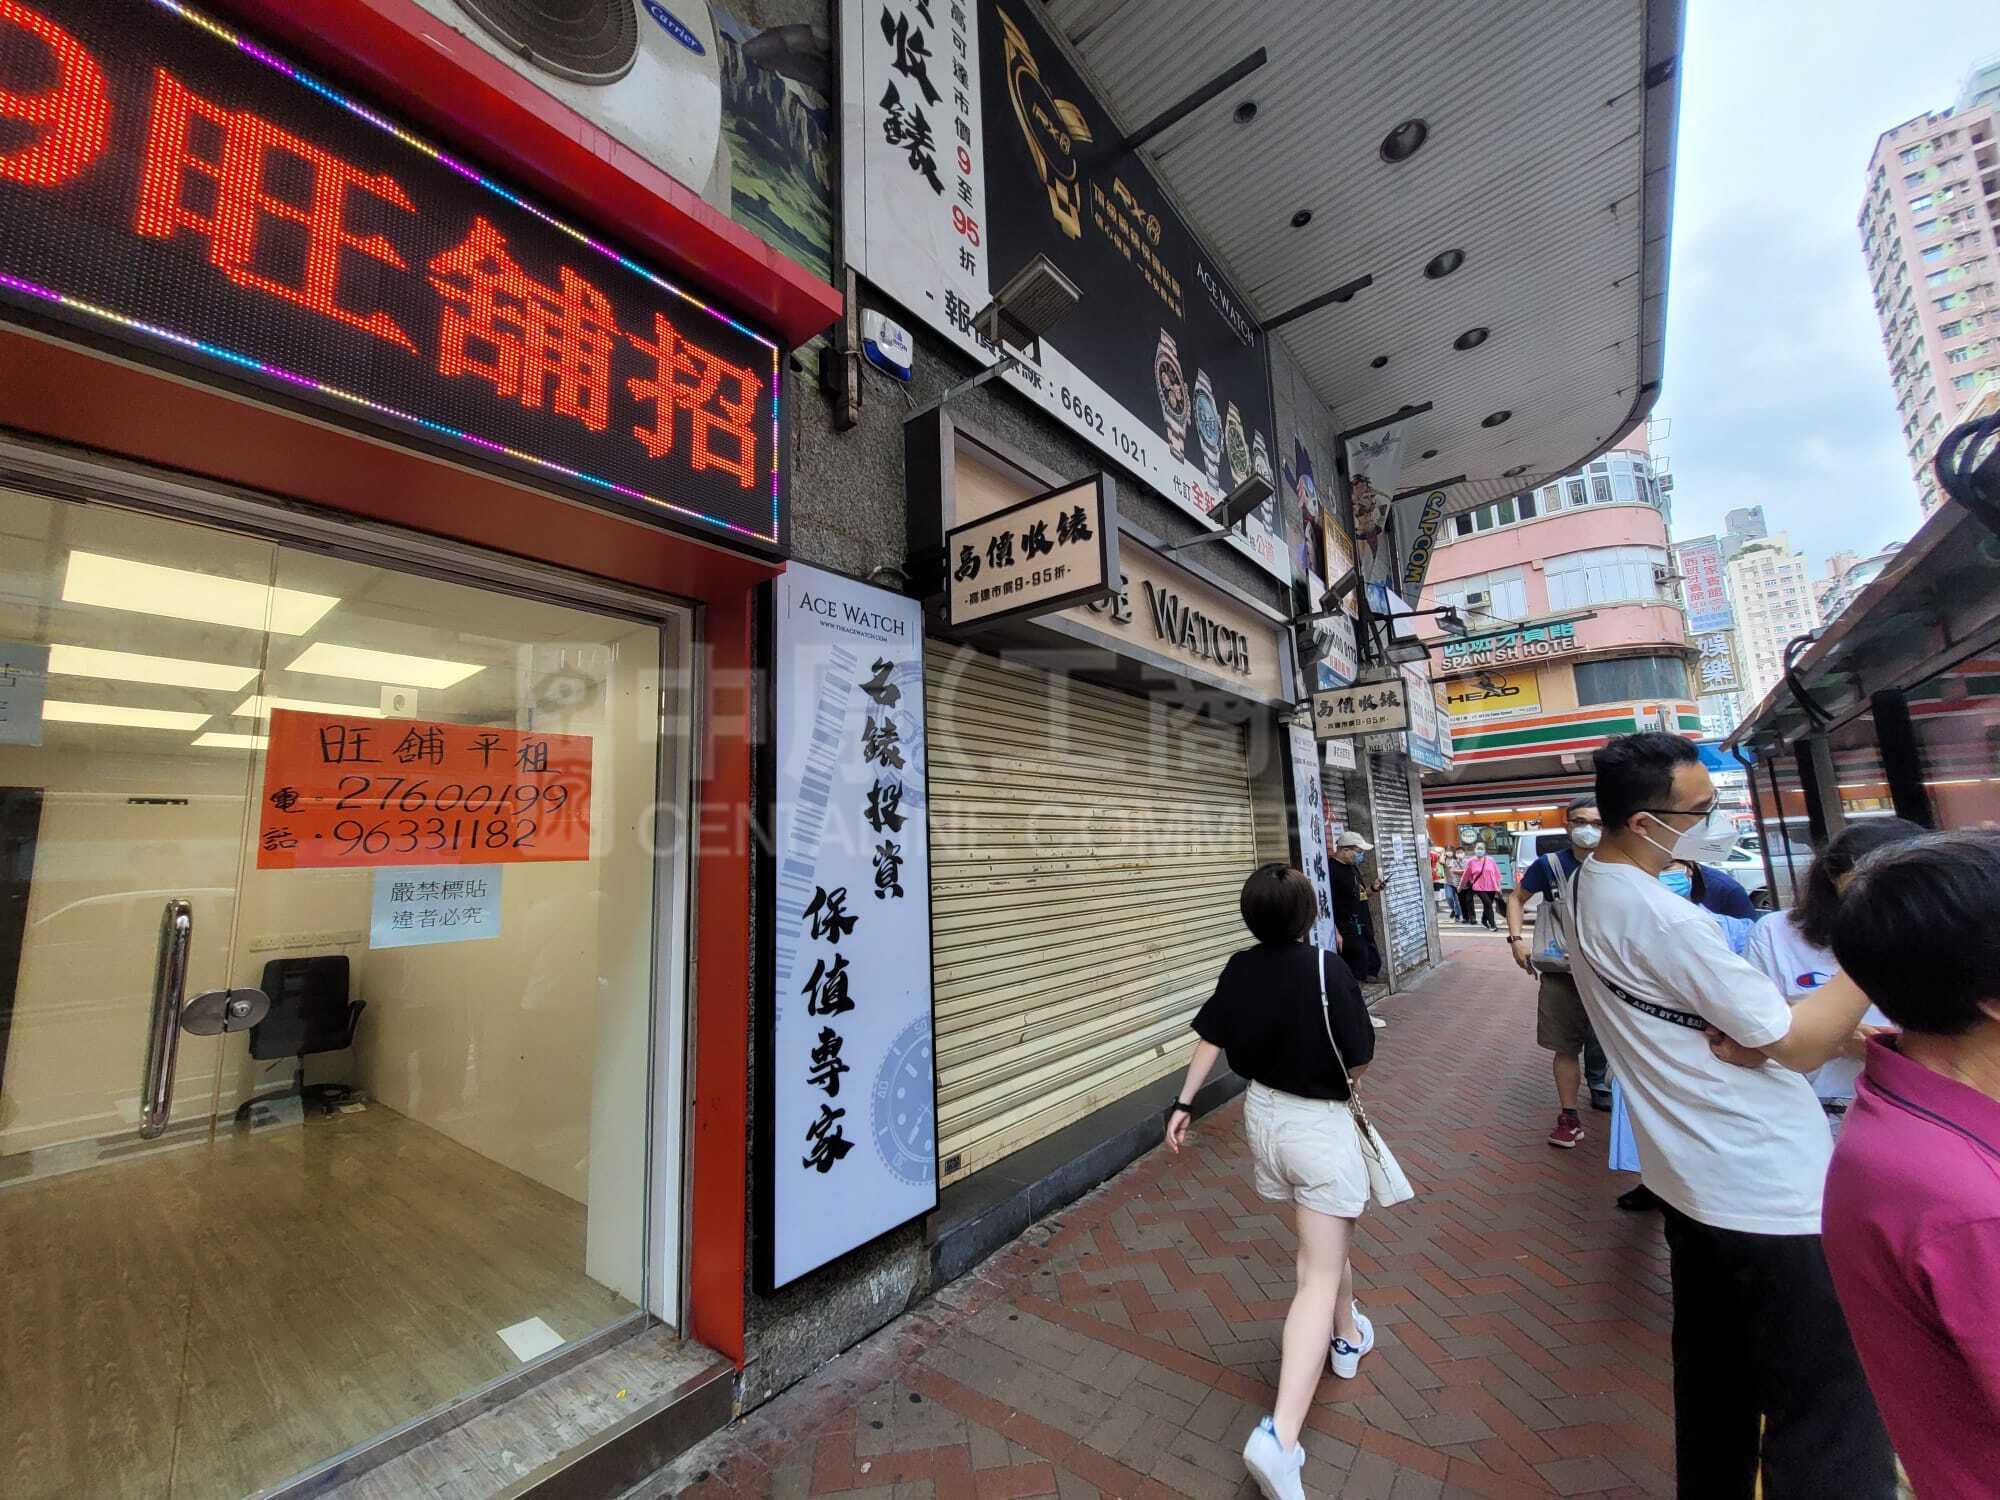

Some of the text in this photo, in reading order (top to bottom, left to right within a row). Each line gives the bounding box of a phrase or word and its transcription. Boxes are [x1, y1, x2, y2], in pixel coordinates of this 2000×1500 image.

[651, 6, 698, 46] Carrier
[880, 0, 945, 196] 收錶
[950, 0, 980, 277] 高可達市價9至95折
[1197, 262, 1218, 300] ACE
[1218, 287, 1255, 348] WATCH
[1060, 386, 1105, 436] 6662
[1112, 426, 1147, 468] 1021
[954, 505, 1094, 582] 高價收錶
[1403, 490, 1447, 583] CAPCOM
[799, 591, 905, 636] ACE WATCH
[1143, 580, 1252, 676] WATCH
[1524, 636, 1579, 657] HOTEL
[1697, 634, 1734, 687] 娛樂
[1317, 690, 1401, 718] 高價收錶
[1447, 686, 1520, 705] HEAD
[320, 725, 562, 774] 旺舖平租
[336, 775, 570, 816] 27600199
[859, 656, 907, 899] 名錶投資
[333, 817, 538, 856] 96331182
[390, 879, 488, 904] 嚴禁標貼
[391, 907, 482, 930] 違者必究
[802, 886, 859, 1171] 保值專家
